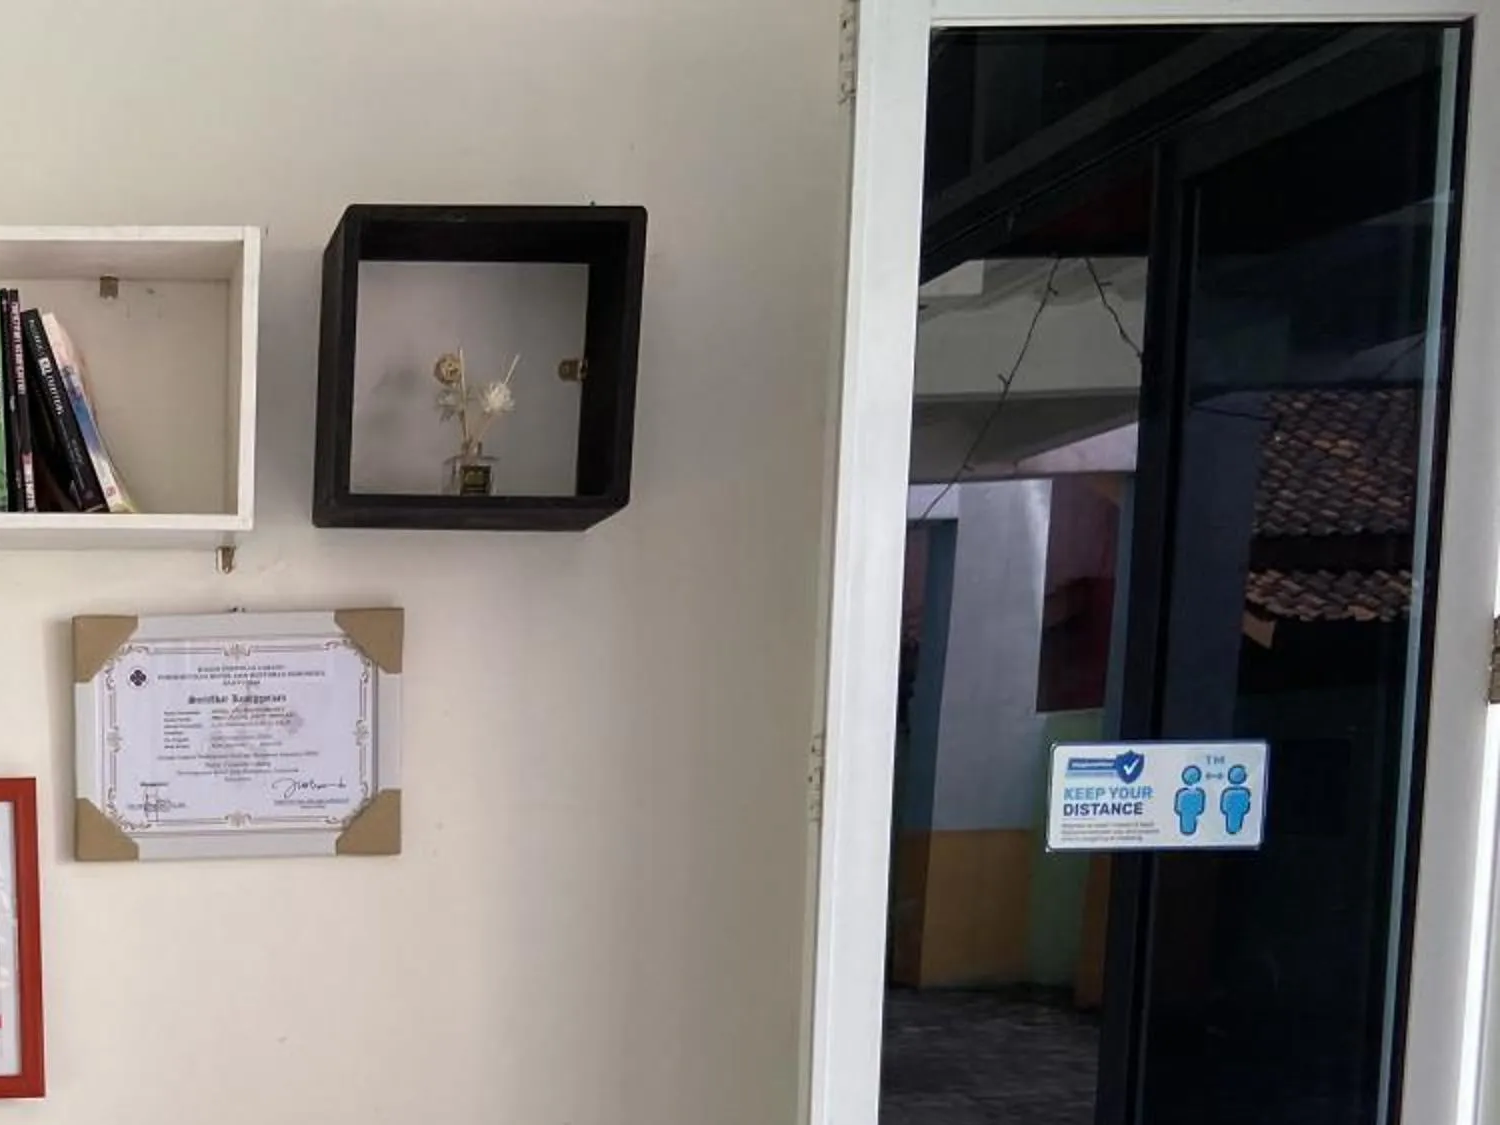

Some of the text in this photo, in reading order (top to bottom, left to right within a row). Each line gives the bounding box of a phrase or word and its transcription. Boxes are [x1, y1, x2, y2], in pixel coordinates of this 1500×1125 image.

[1063, 785, 1155, 801] KEEP YOUR
[1063, 802, 1145, 817] DISTANCE
